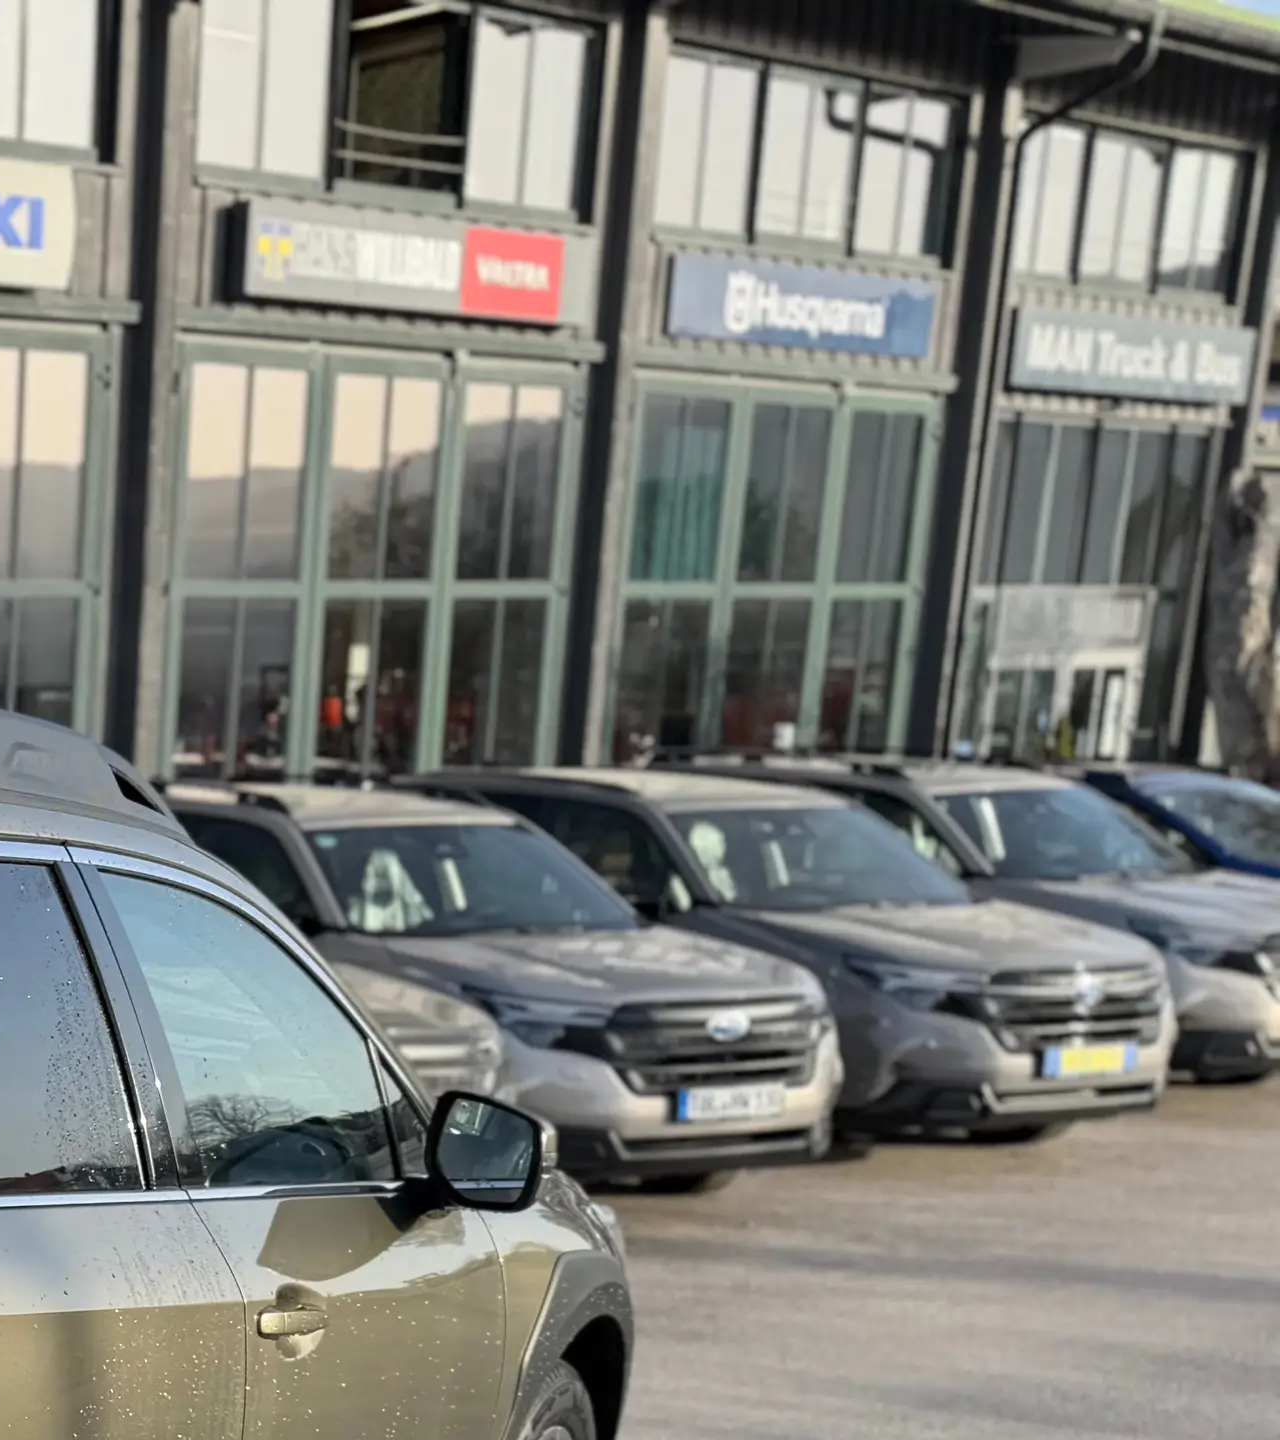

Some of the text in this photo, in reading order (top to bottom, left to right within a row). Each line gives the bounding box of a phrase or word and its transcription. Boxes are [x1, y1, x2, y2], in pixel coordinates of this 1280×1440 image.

[1026, 323, 1093, 376] MAN
[1096, 331, 1166, 381] Truck
[1193, 340, 1242, 386] Bus
